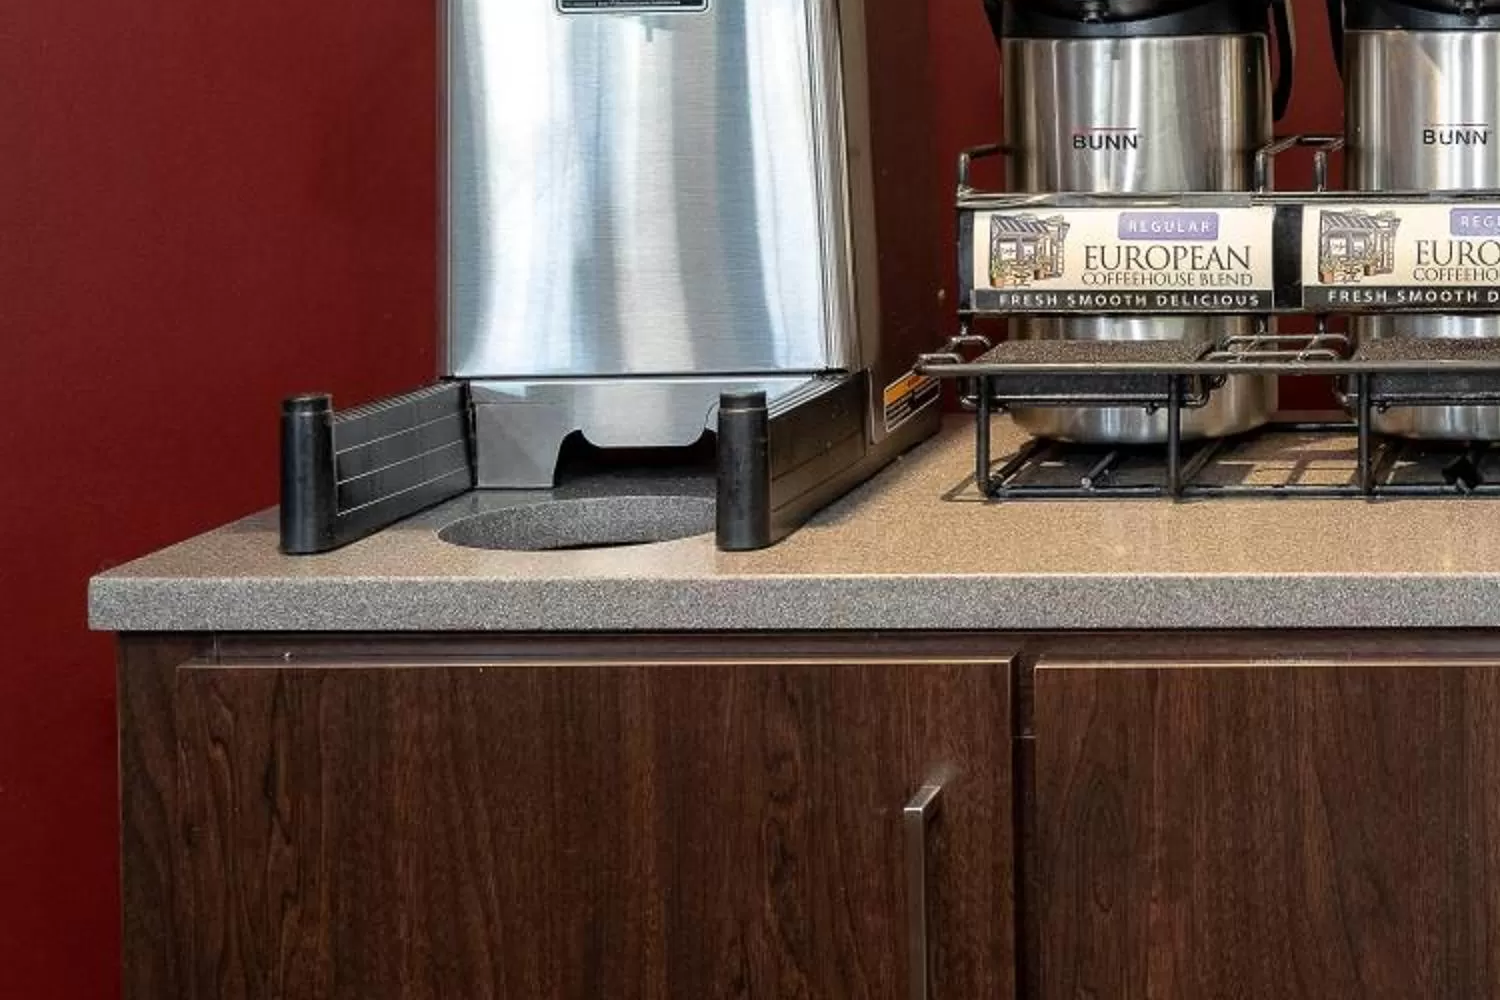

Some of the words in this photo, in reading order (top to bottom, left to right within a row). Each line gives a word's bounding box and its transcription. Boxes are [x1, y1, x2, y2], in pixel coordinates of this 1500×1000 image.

[1072, 134, 1138, 150] BUNN
[1422, 129, 1490, 145] BUNN
[1128, 219, 1212, 234] REGULAR
[1084, 245, 1253, 271] EUROPEAN
[1081, 271, 1195, 287] COFFEEHOUSE
[1199, 271, 1254, 287] BLEND
[1000, 294, 1058, 306] FRESH
[1066, 294, 1148, 307] SMOOTH
[1156, 294, 1261, 307] DELICIOUS
[1328, 291, 1389, 304] FRESH
[1396, 290, 1478, 303] SMOOTH
